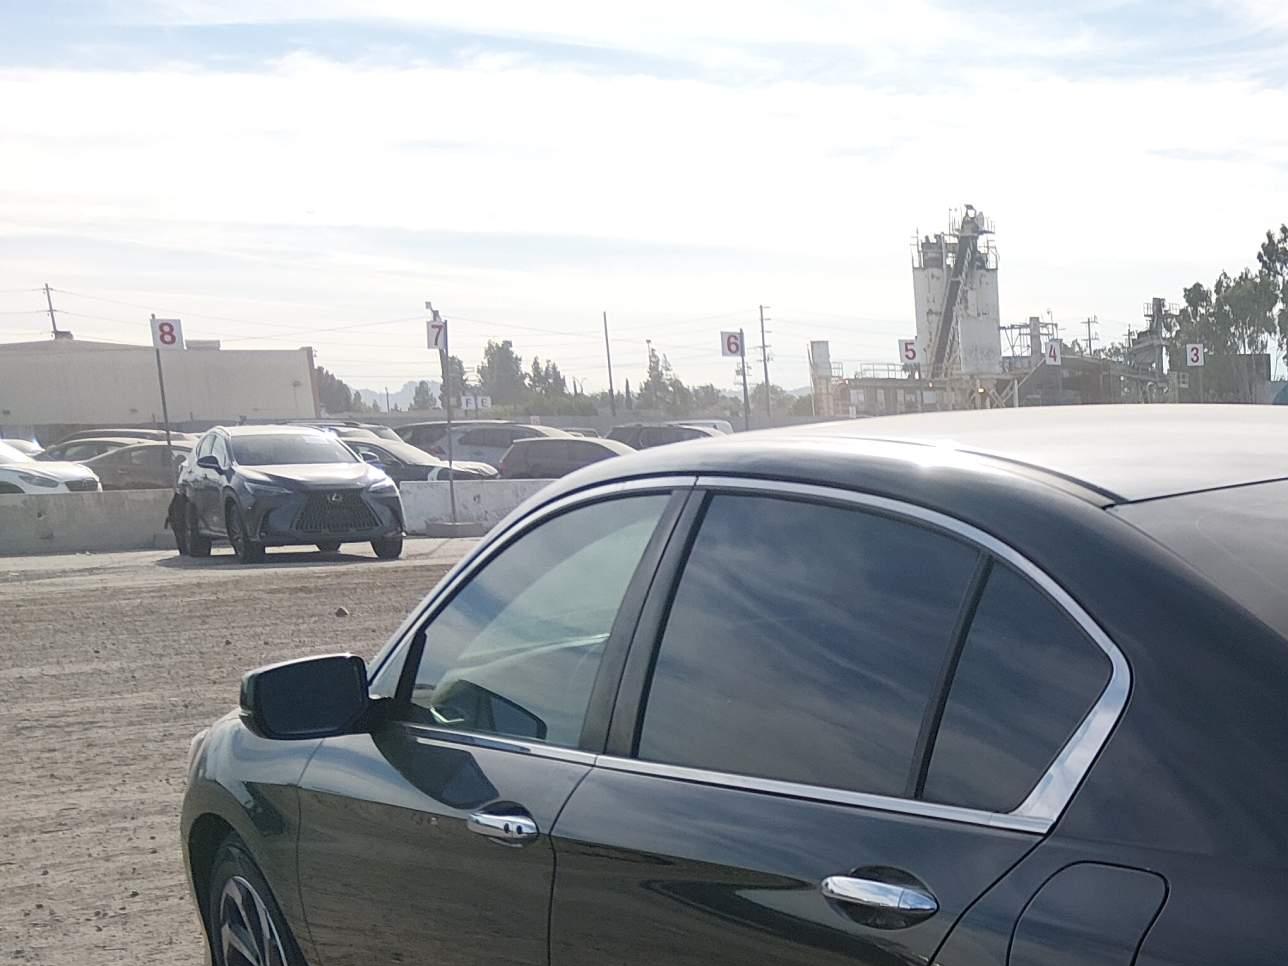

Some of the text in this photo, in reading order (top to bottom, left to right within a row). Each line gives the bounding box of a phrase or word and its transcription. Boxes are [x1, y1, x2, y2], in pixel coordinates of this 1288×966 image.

[158, 322, 177, 345] 8
[431, 324, 444, 346] 7
[726, 334, 740, 354] 6
[904, 342, 917, 360] 5
[1048, 344, 1057, 363] 4
[1190, 346, 1200, 363] 3
